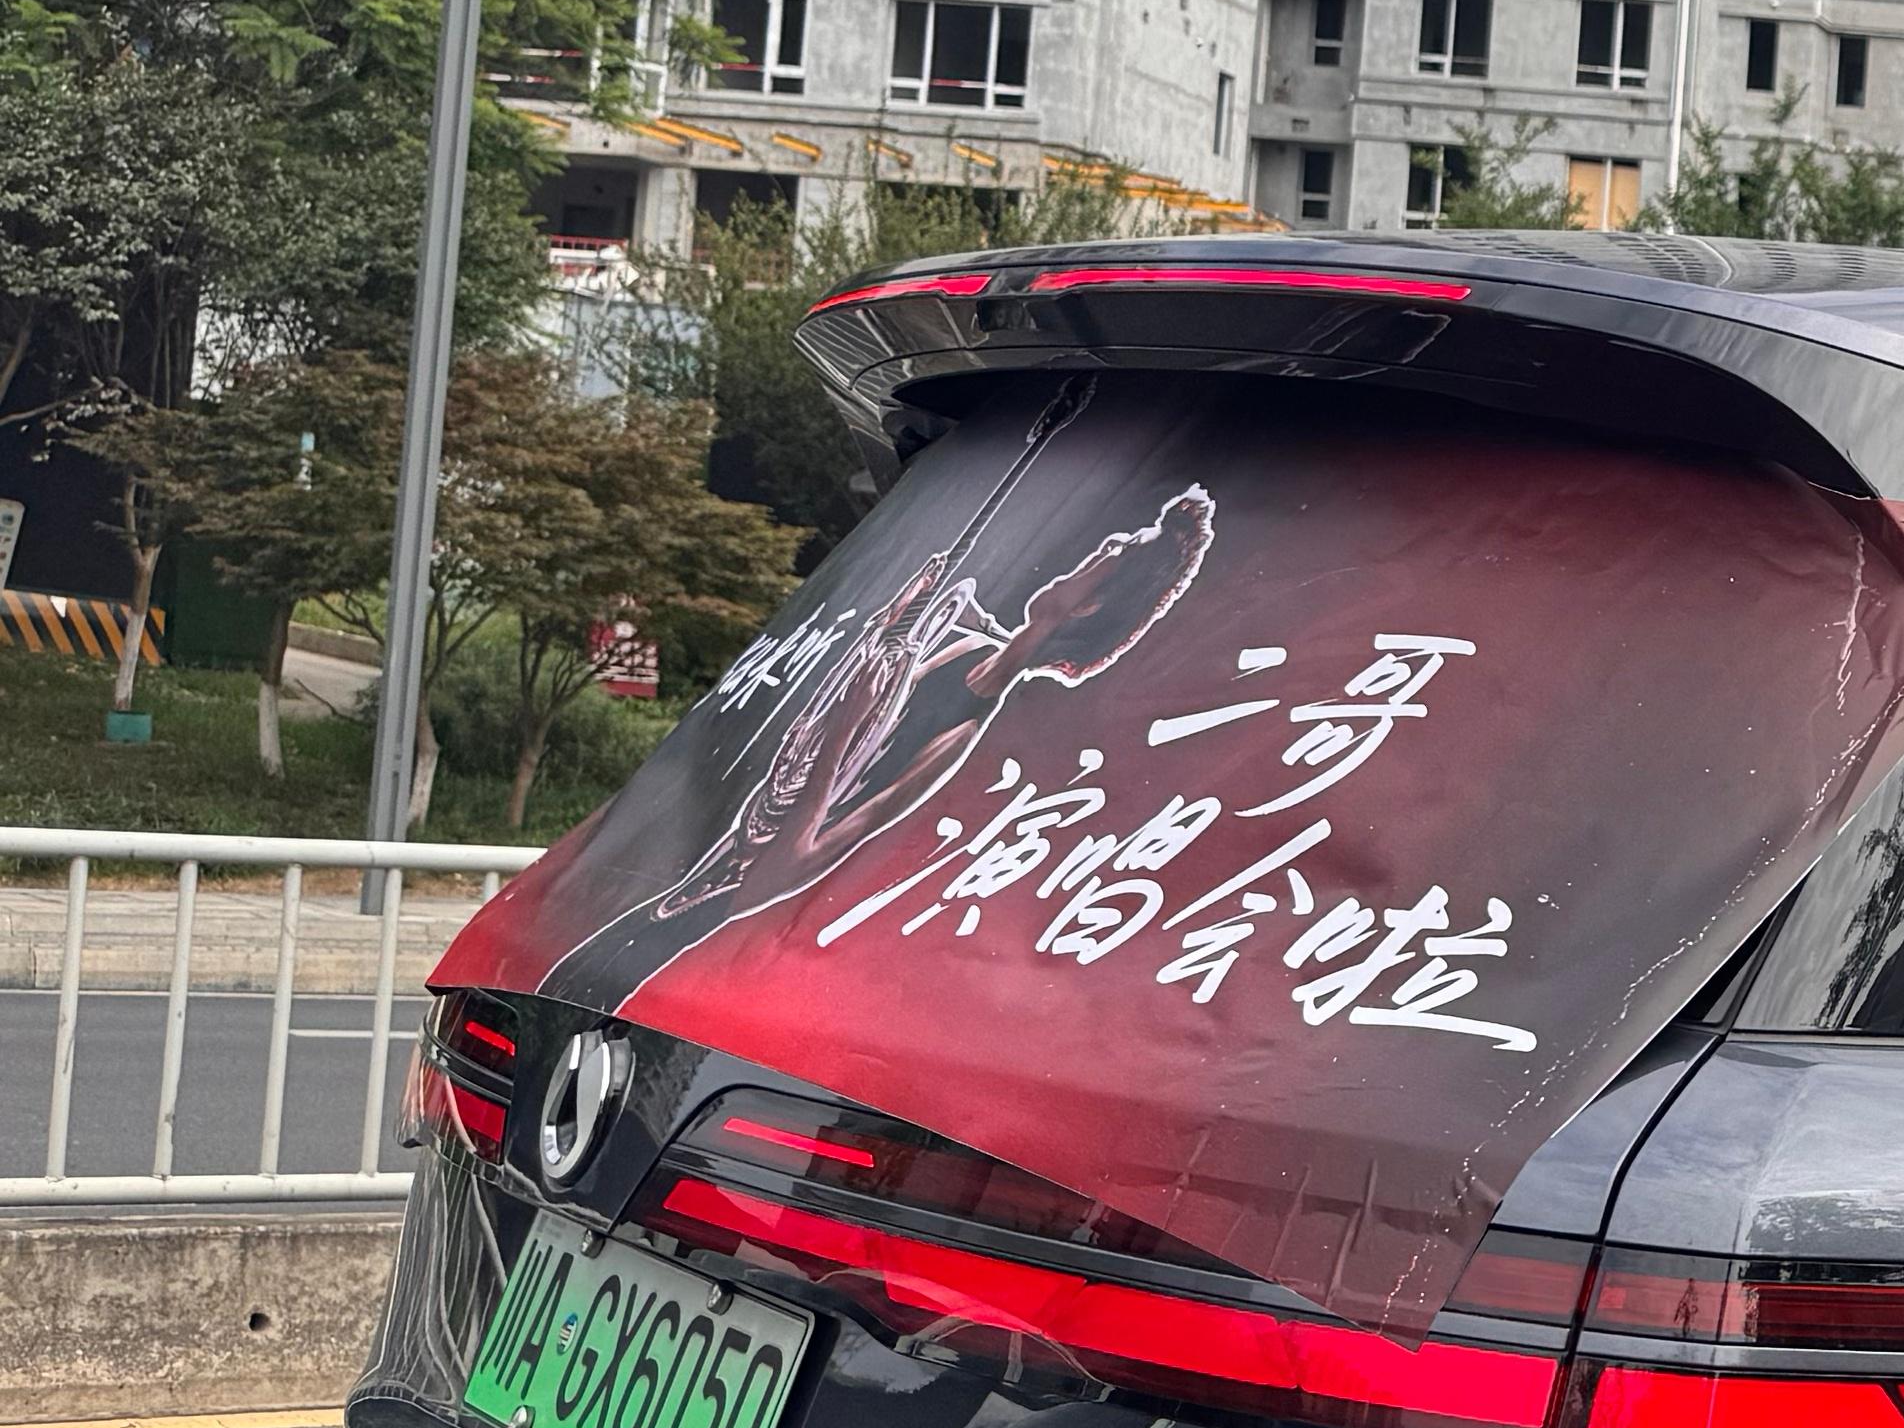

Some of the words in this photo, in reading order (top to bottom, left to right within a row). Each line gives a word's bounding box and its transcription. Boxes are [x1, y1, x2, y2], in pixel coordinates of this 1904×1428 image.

[1148, 634, 1475, 817] 二哥
[817, 748, 1536, 1051] 演唱会啦
